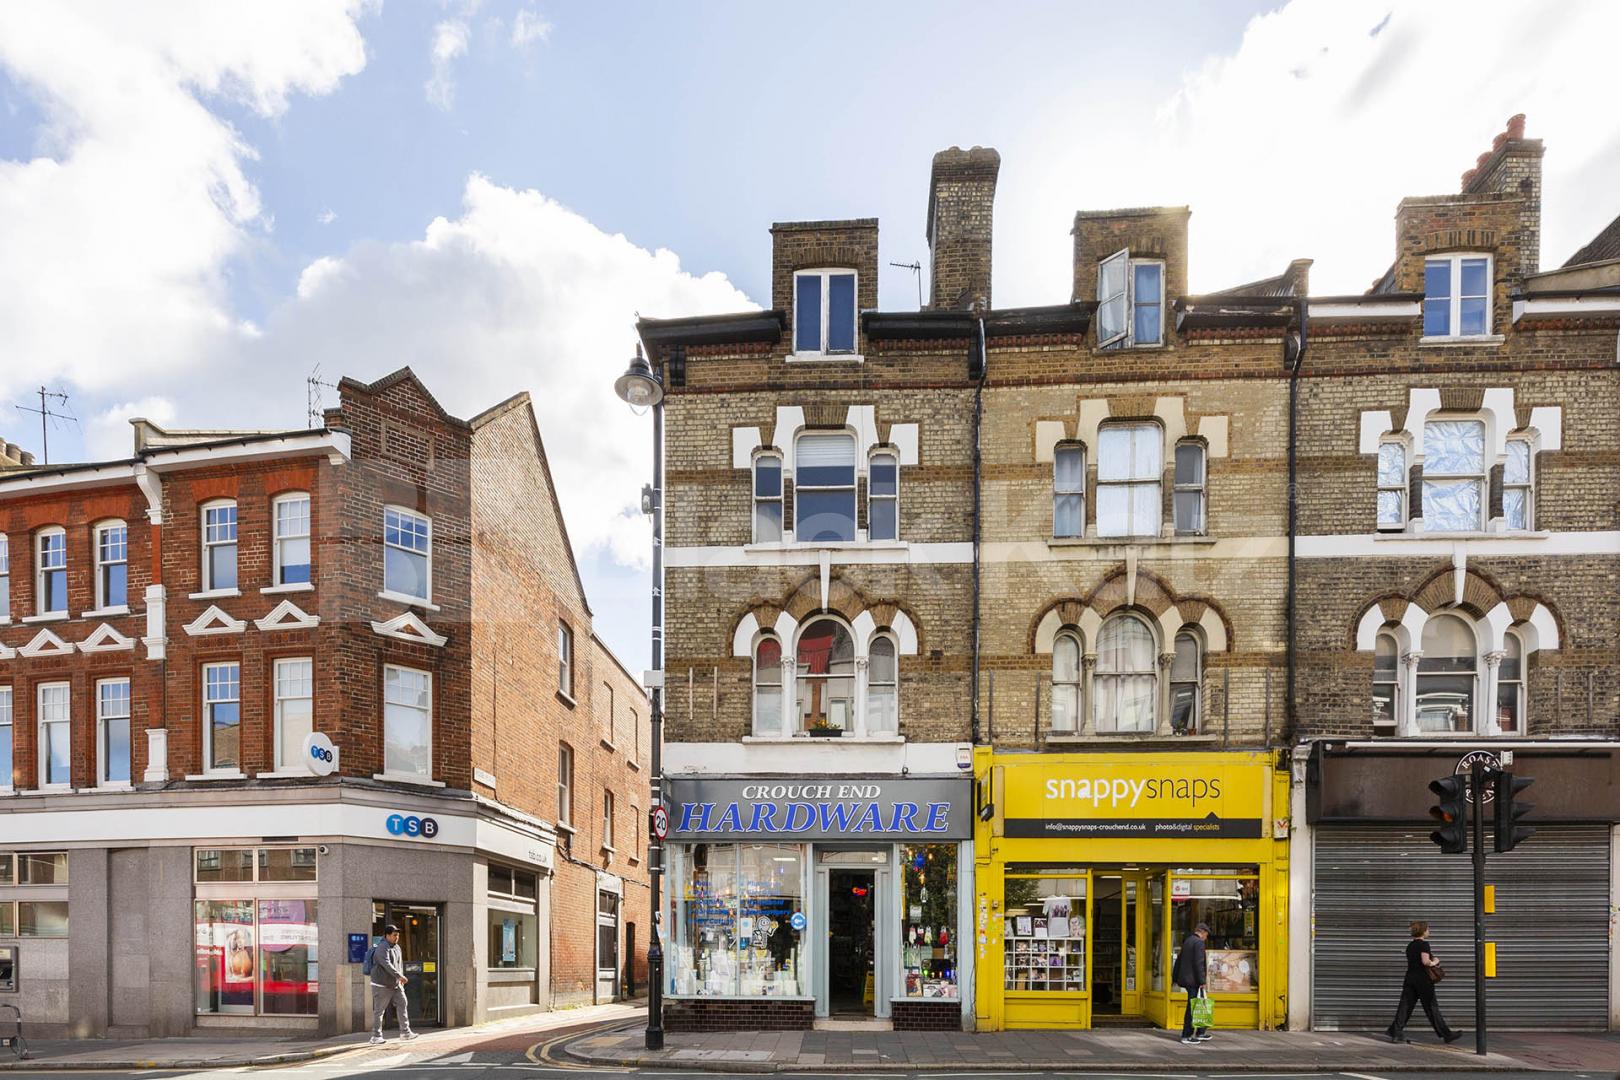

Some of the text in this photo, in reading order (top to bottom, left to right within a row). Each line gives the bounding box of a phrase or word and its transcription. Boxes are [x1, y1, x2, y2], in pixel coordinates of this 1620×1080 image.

[312, 747, 332, 762] TSB
[741, 785, 881, 799] CROUCH END
[1045, 778, 1221, 808] snappysnaps
[656, 816, 666, 830] 20
[676, 802, 950, 833] HARDWARE
[389, 816, 437, 836] TSB
[1045, 823, 1147, 832] info@snappysnaps-crouchend.co.uk
[1193, 823, 1221, 832] specialists
